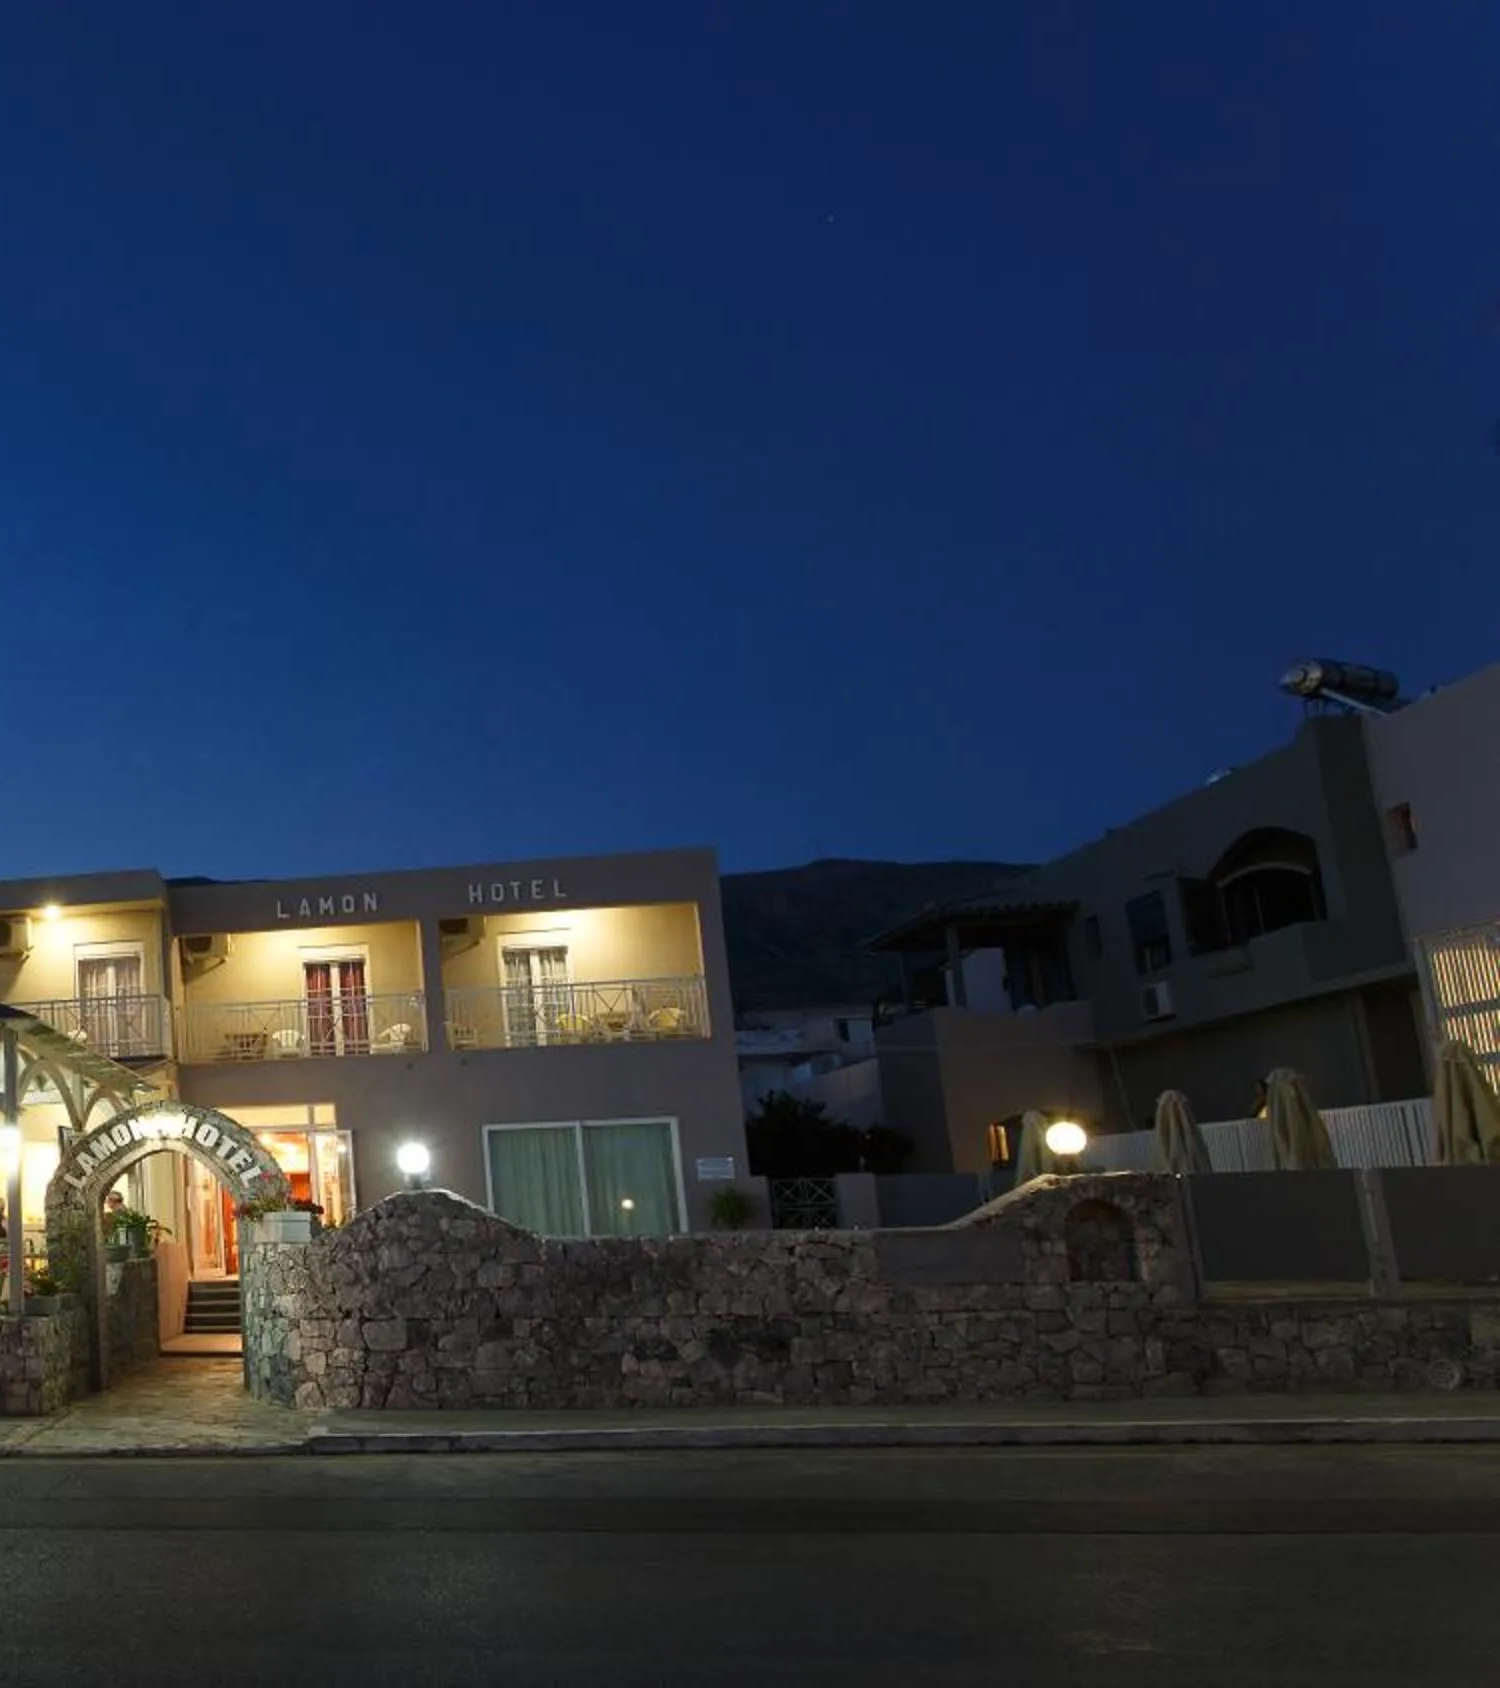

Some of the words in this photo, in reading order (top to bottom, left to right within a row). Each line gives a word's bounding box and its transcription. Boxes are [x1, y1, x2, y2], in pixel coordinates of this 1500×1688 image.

[277, 892, 378, 919] LAMON
[468, 879, 567, 903] HOTEL
[177, 1112, 262, 1189] HOTEL
